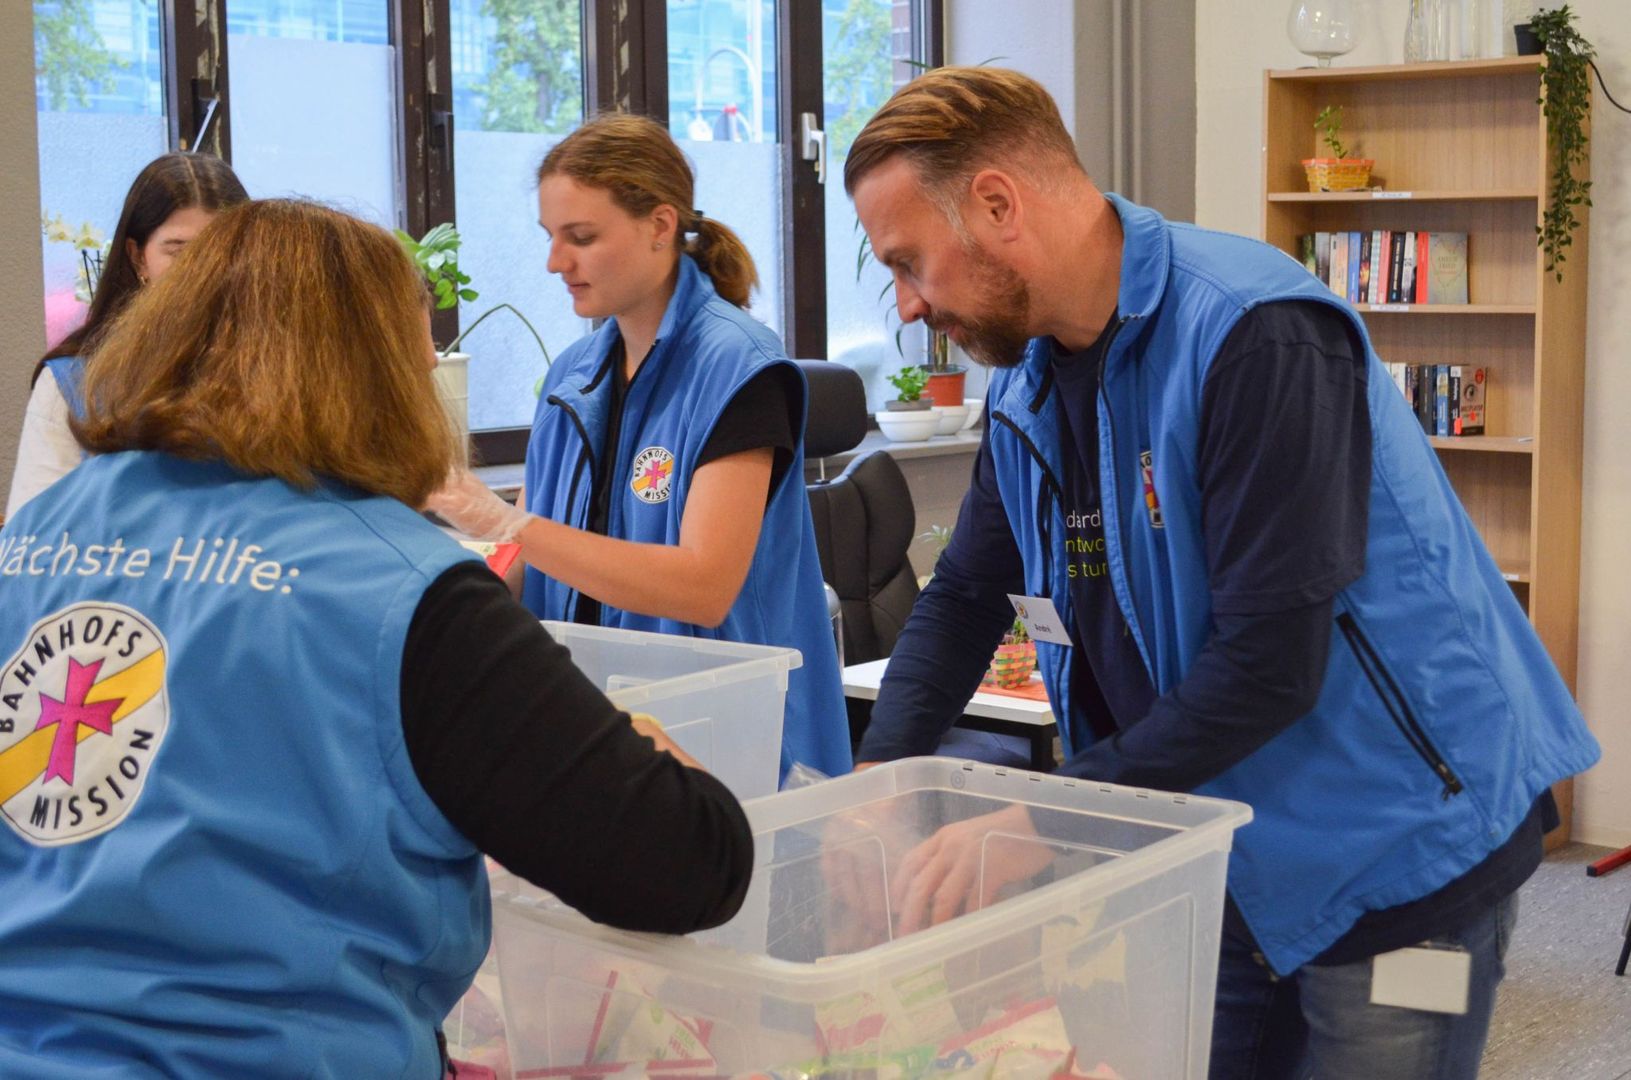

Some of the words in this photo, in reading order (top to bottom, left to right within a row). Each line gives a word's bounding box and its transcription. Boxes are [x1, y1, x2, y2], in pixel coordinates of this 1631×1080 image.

[644, 483, 671, 499] MISSI
[163, 536, 300, 594] Hilfe:
[0, 616, 142, 734] BAHNHOFS
[30, 729, 154, 830] MISSION
